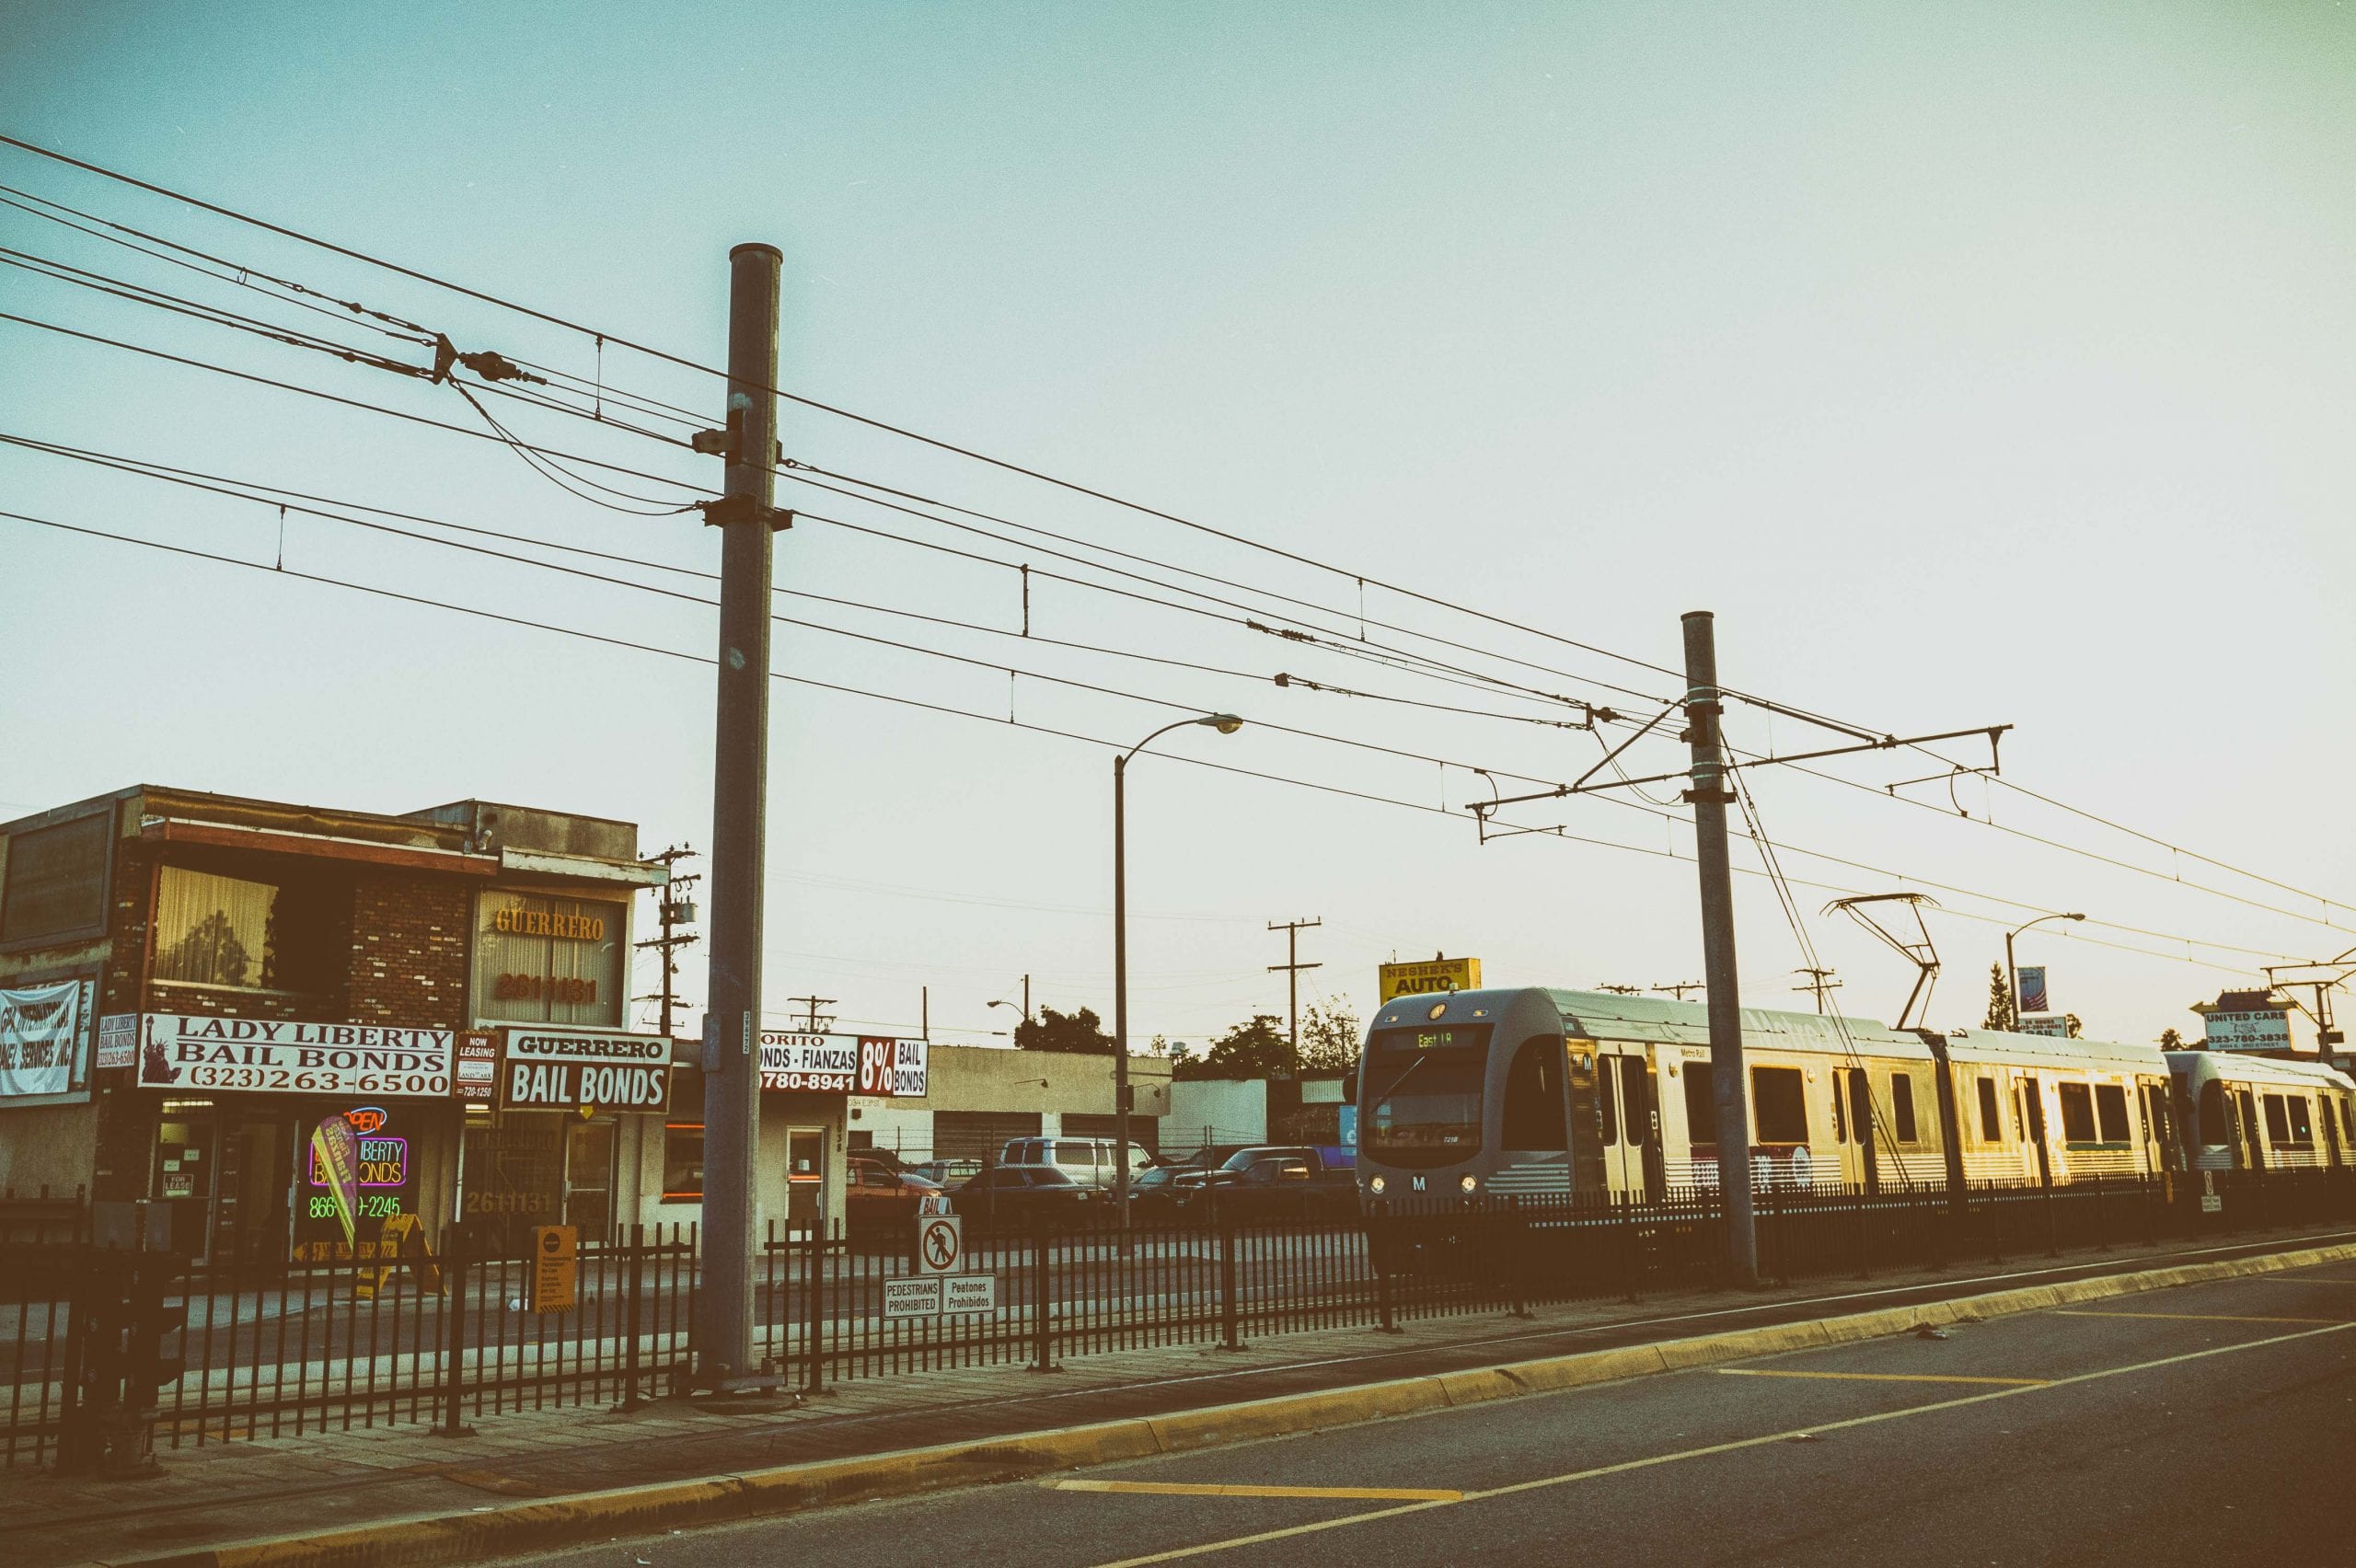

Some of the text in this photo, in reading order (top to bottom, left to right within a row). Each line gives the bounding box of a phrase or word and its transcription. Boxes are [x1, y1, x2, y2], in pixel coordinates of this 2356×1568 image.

[496, 907, 605, 940] GUERRERO
[1386, 963, 1462, 977] NESHEK'S
[1395, 975, 1452, 994] AUTO
[2206, 1011, 2286, 1022] UNITED CARS
[101, 1017, 115, 1031] LADY
[177, 1017, 452, 1049] LADY LIBERTY
[760, 1033, 825, 1047] ORITO
[1418, 1033, 1437, 1047] East
[2209, 1033, 2288, 1043] 323-780-3838
[99, 1032, 134, 1049] BAIL BONDS
[469, 1037, 488, 1047] NOW
[517, 1036, 664, 1058] GUERRERO
[175, 1043, 445, 1072] BAIL BONDS
[459, 1046, 496, 1058] LEASING
[899, 1043, 921, 1066] BAIL
[802, 1049, 856, 1071] FIANZAS
[860, 1041, 893, 1092] 8%
[512, 1064, 664, 1105] BAIL BONDS
[895, 1069, 924, 1092] BONDS
[463, 1086, 492, 1097] 720-1250
[360, 1140, 403, 1162] IBERTY
[360, 1162, 401, 1183] ONDS
[166, 1182, 190, 1190] LEASE
[1413, 1176, 1426, 1191] M
[886, 1283, 939, 1297] PEDESTRIANS
[952, 1282, 987, 1294] Peatones
[888, 1298, 936, 1312] PROHIBITED
[948, 1296, 989, 1309] Prohibidos
